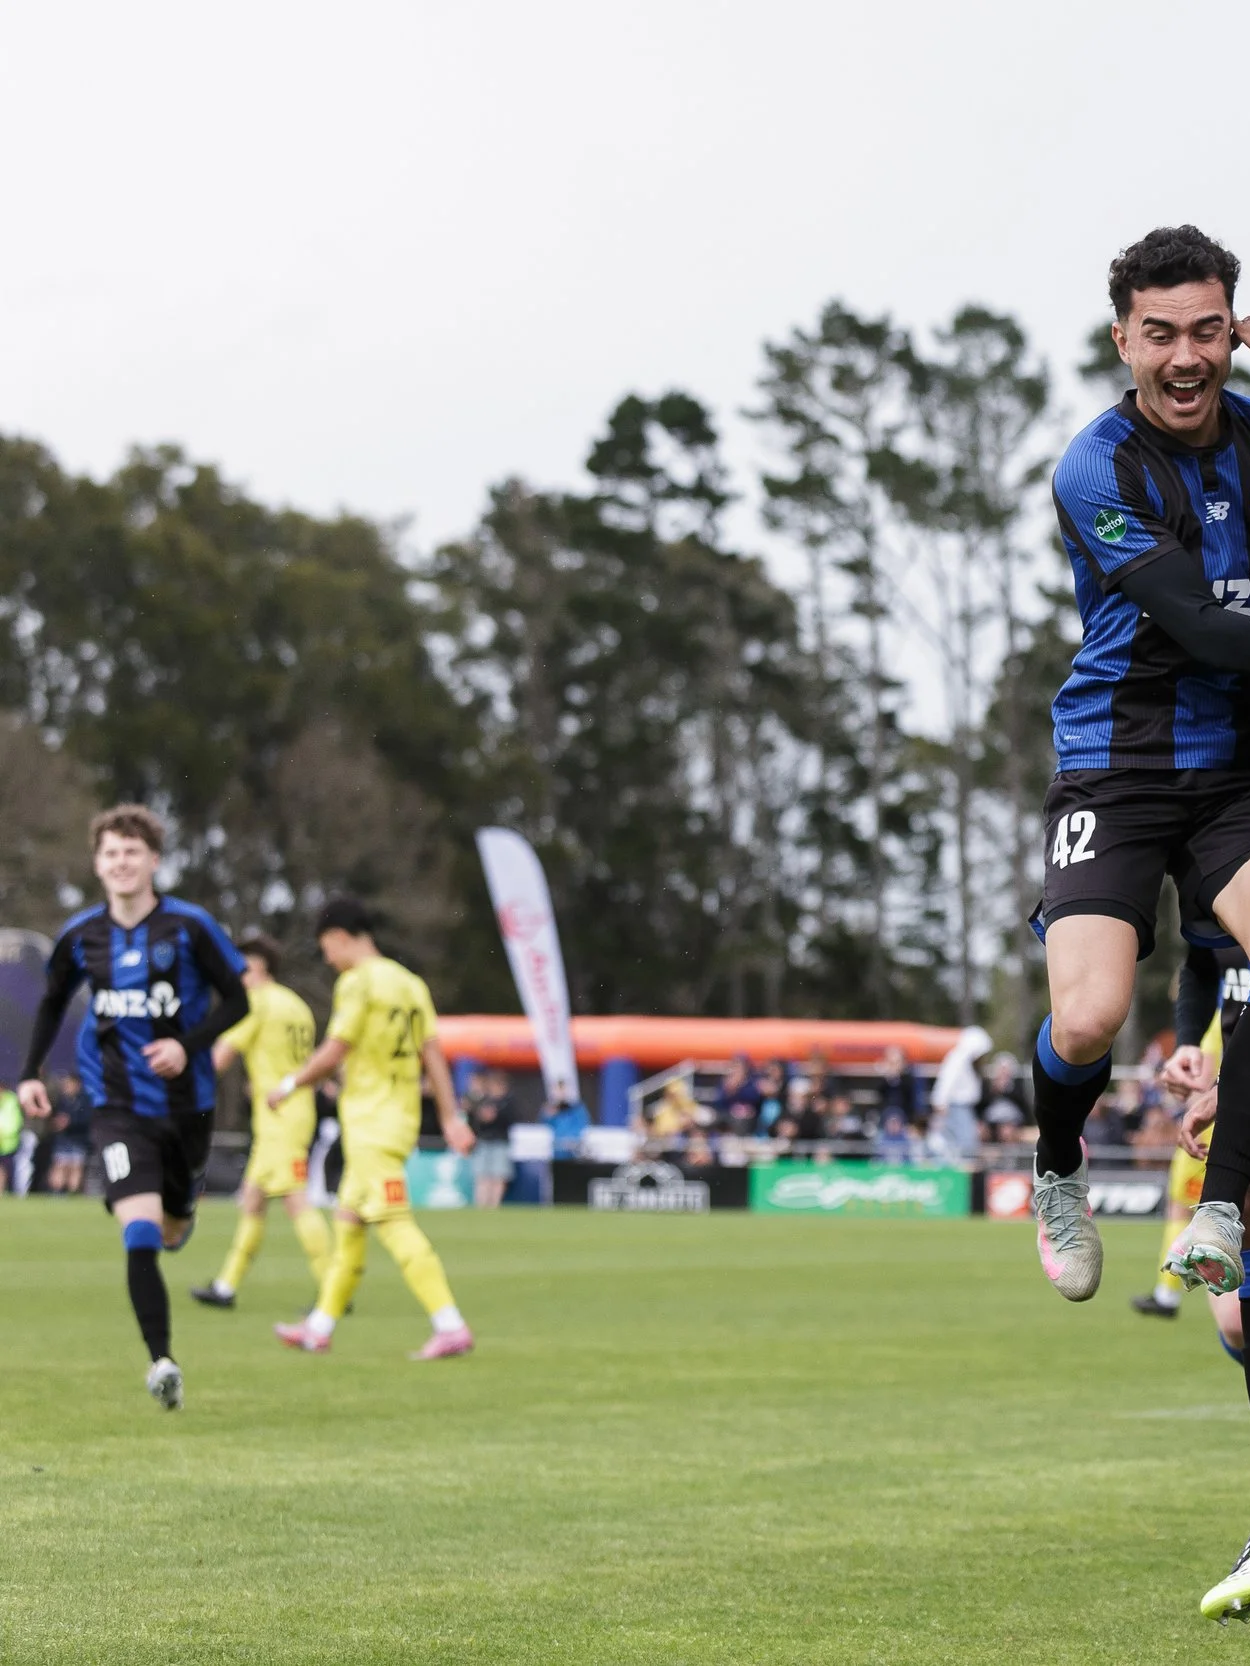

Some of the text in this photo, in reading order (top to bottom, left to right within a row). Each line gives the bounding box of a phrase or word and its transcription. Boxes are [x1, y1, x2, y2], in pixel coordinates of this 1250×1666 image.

[1096, 514, 1124, 536] Dettol
[1052, 810, 1097, 870] 42
[94, 988, 148, 1018] ANZ
[388, 1007, 425, 1058] 20
